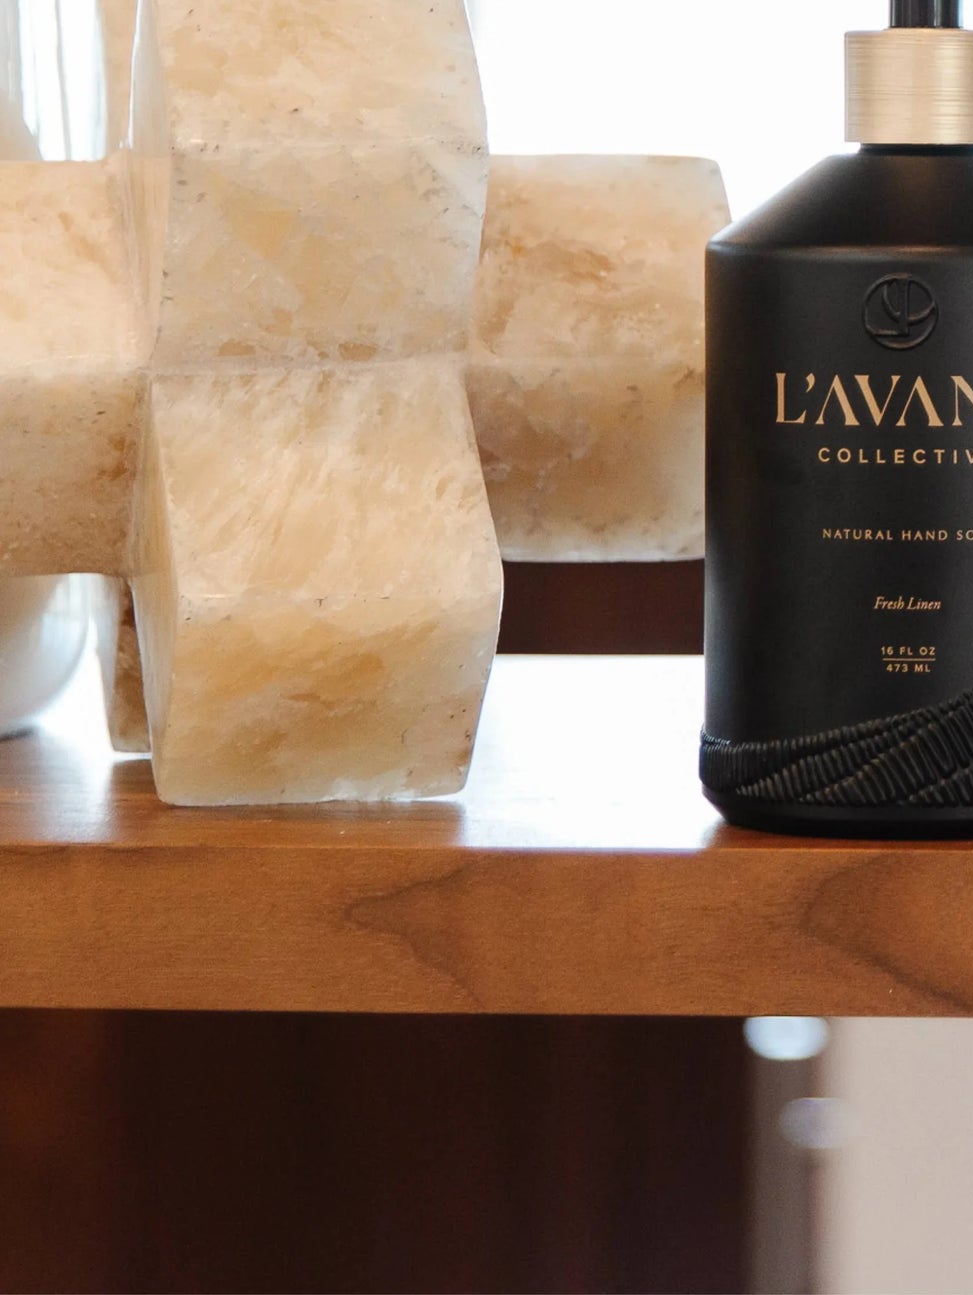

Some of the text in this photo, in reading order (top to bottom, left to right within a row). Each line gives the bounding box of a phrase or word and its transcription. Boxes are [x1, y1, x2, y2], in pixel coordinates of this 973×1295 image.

[822, 528, 893, 541] NATURAL
[901, 529, 948, 541] HAND
[873, 595, 942, 610] Fresh Linen
[881, 646, 936, 656] 16 FL OZ
[886, 663, 931, 673] 473 ML
